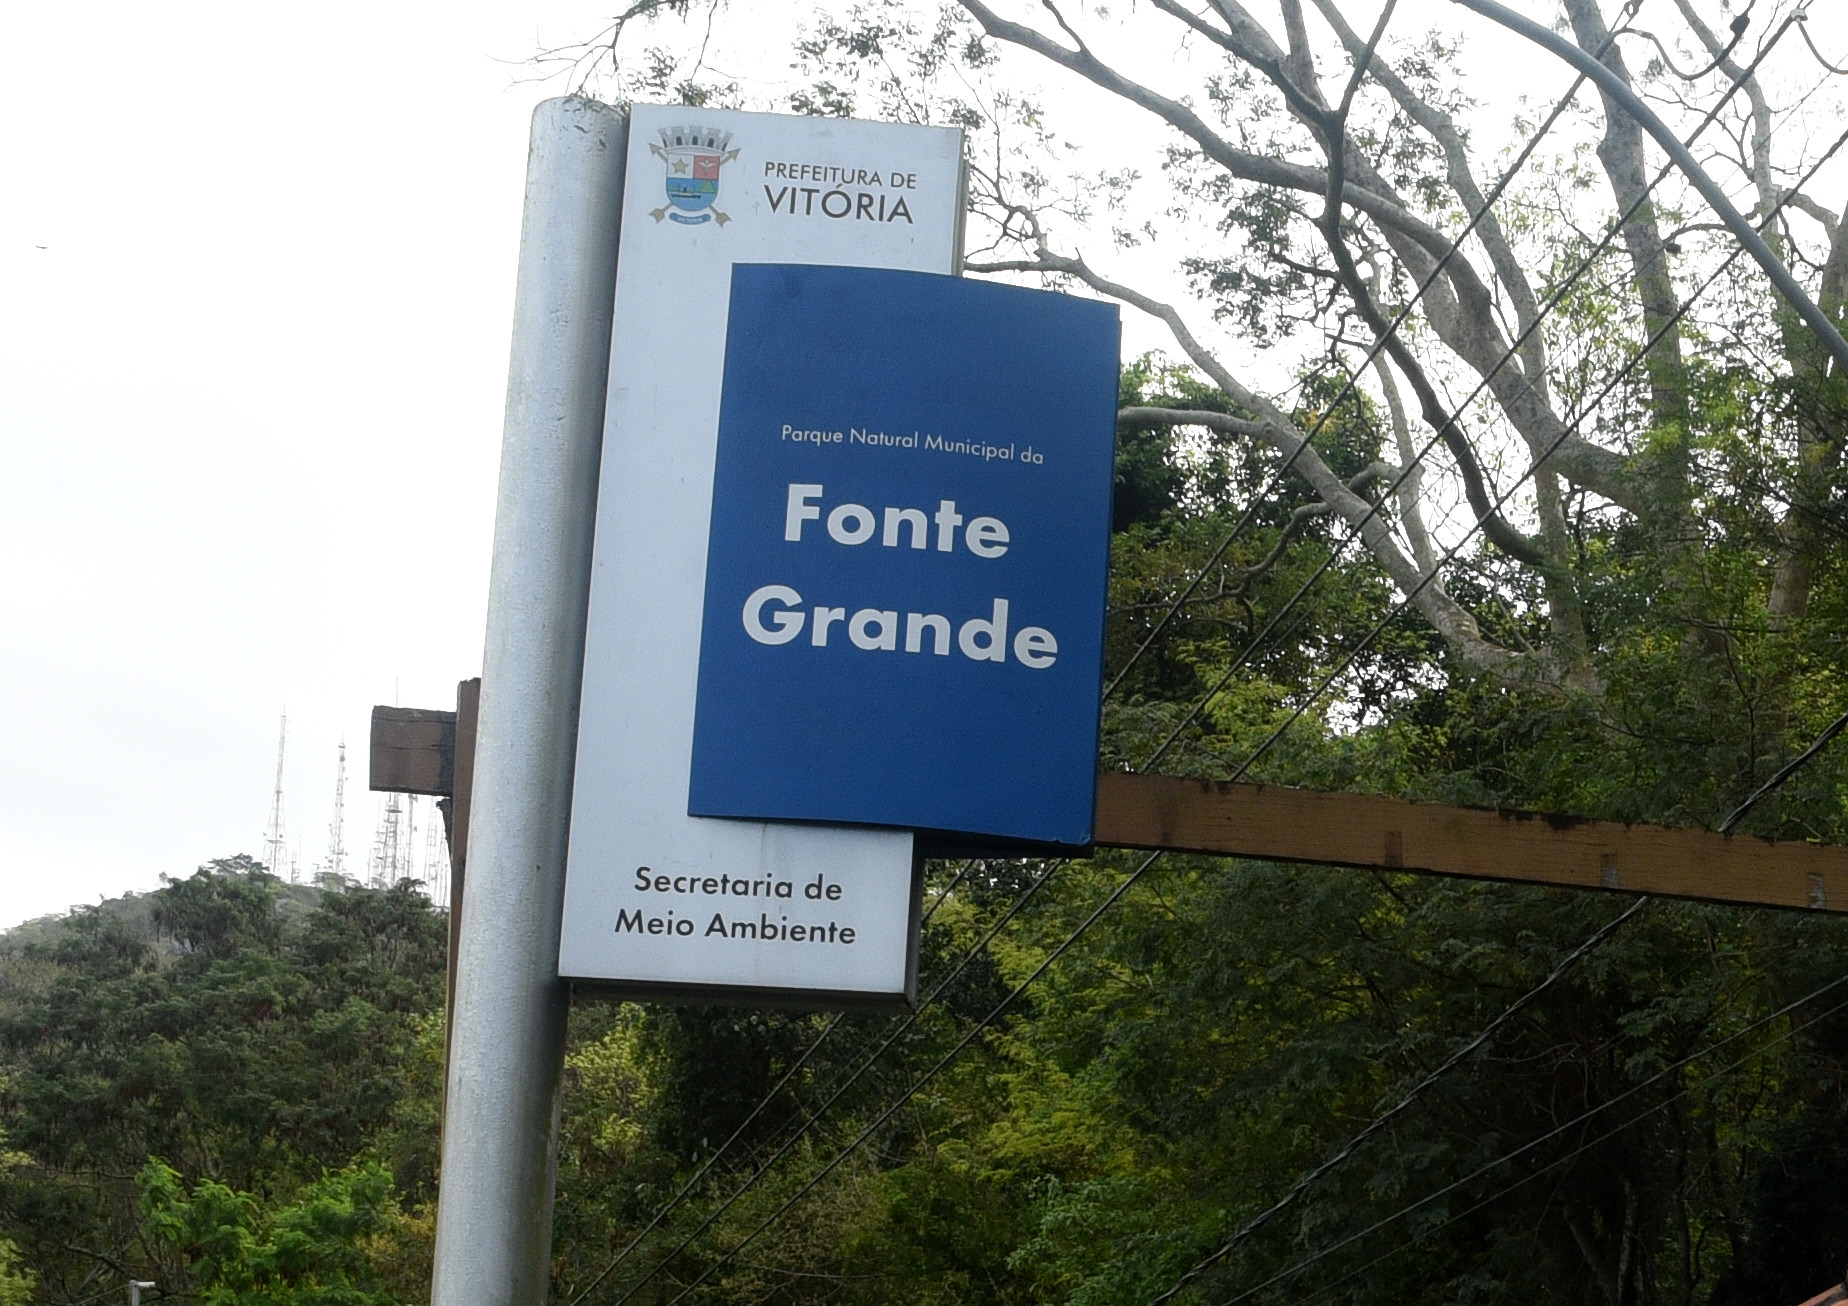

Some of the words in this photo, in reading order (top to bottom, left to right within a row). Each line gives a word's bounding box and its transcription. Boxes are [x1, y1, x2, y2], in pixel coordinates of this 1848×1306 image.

[765, 162, 882, 186] PREFEITURA
[891, 173, 916, 189] DE
[764, 184, 913, 223] VITÓRIA
[782, 425, 842, 446] Parque
[851, 428, 918, 447] Natural
[925, 435, 1014, 461] Municipal
[1021, 446, 1043, 464] da
[785, 484, 1009, 558] Fonte
[743, 585, 1057, 668] Grande
[635, 867, 792, 898] Secretaria
[805, 873, 842, 900] de
[615, 909, 694, 936] Meio
[705, 913, 855, 944] Ambiente
